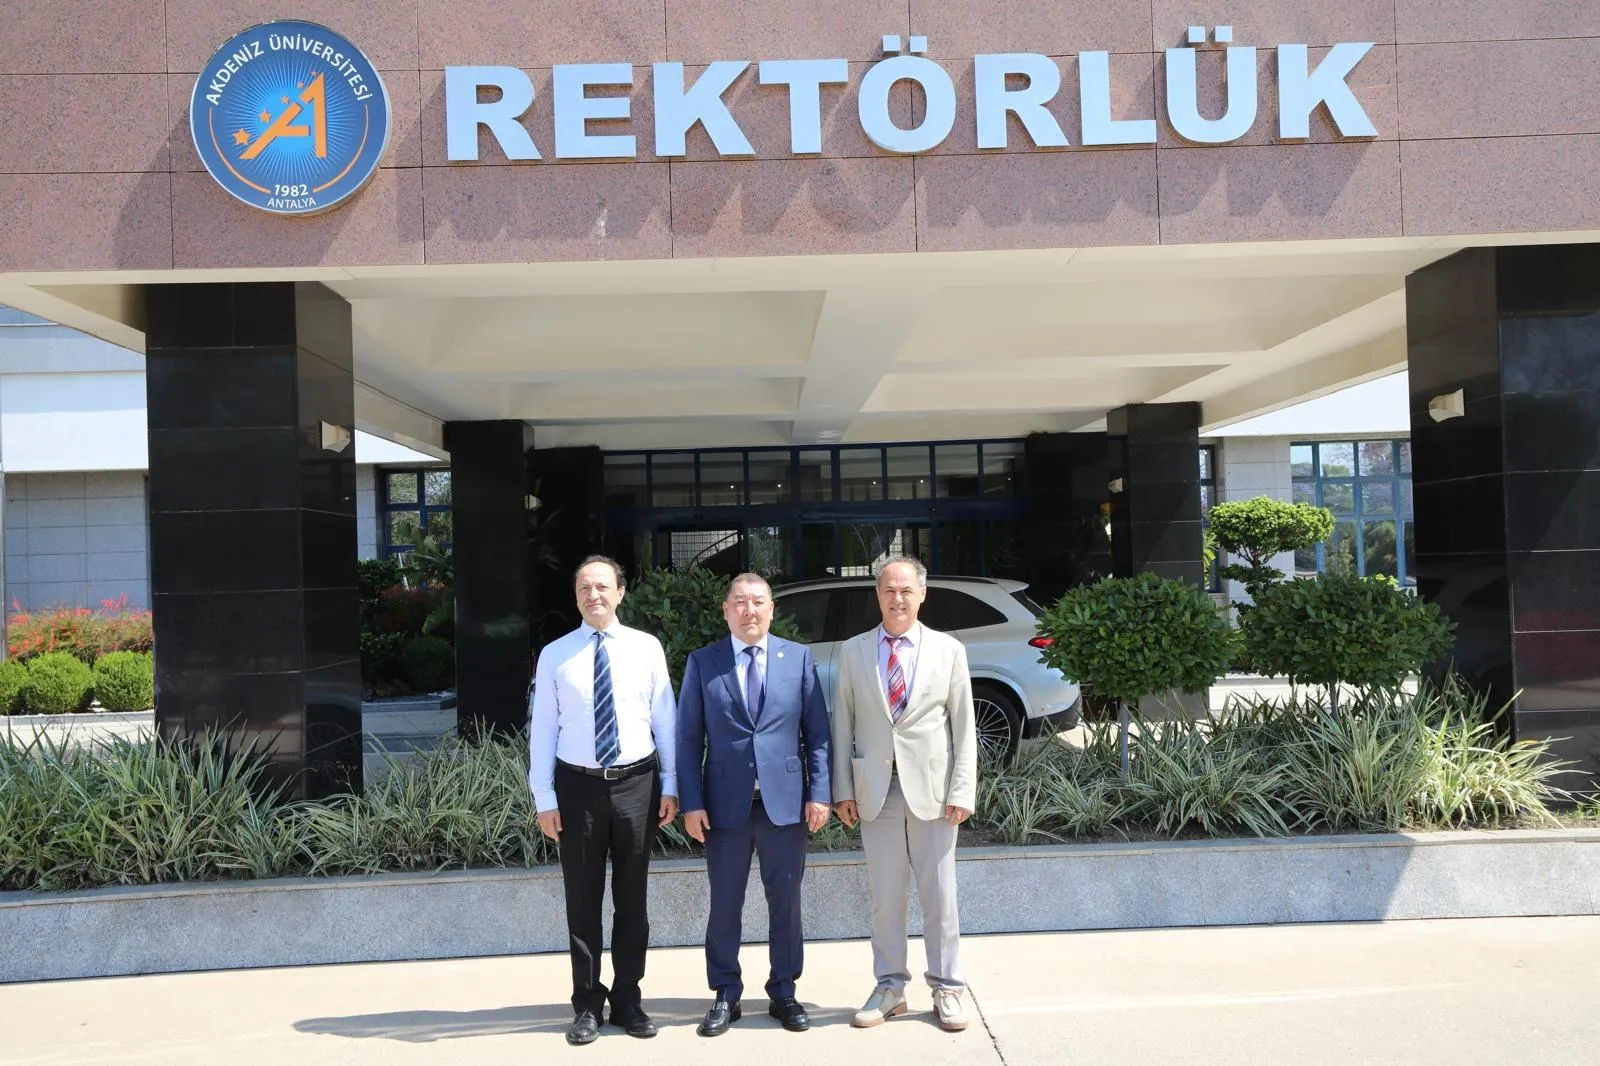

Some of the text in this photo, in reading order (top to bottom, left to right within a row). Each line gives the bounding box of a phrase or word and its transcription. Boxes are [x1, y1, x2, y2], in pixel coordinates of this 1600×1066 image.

[205, 33, 373, 106] AKDENİZ ÜNİVERSİTESİ
[445, 25, 1379, 162] REKTÖRLÜK
[267, 197, 317, 209] ANTALYA
[274, 184, 309, 197] 1982
